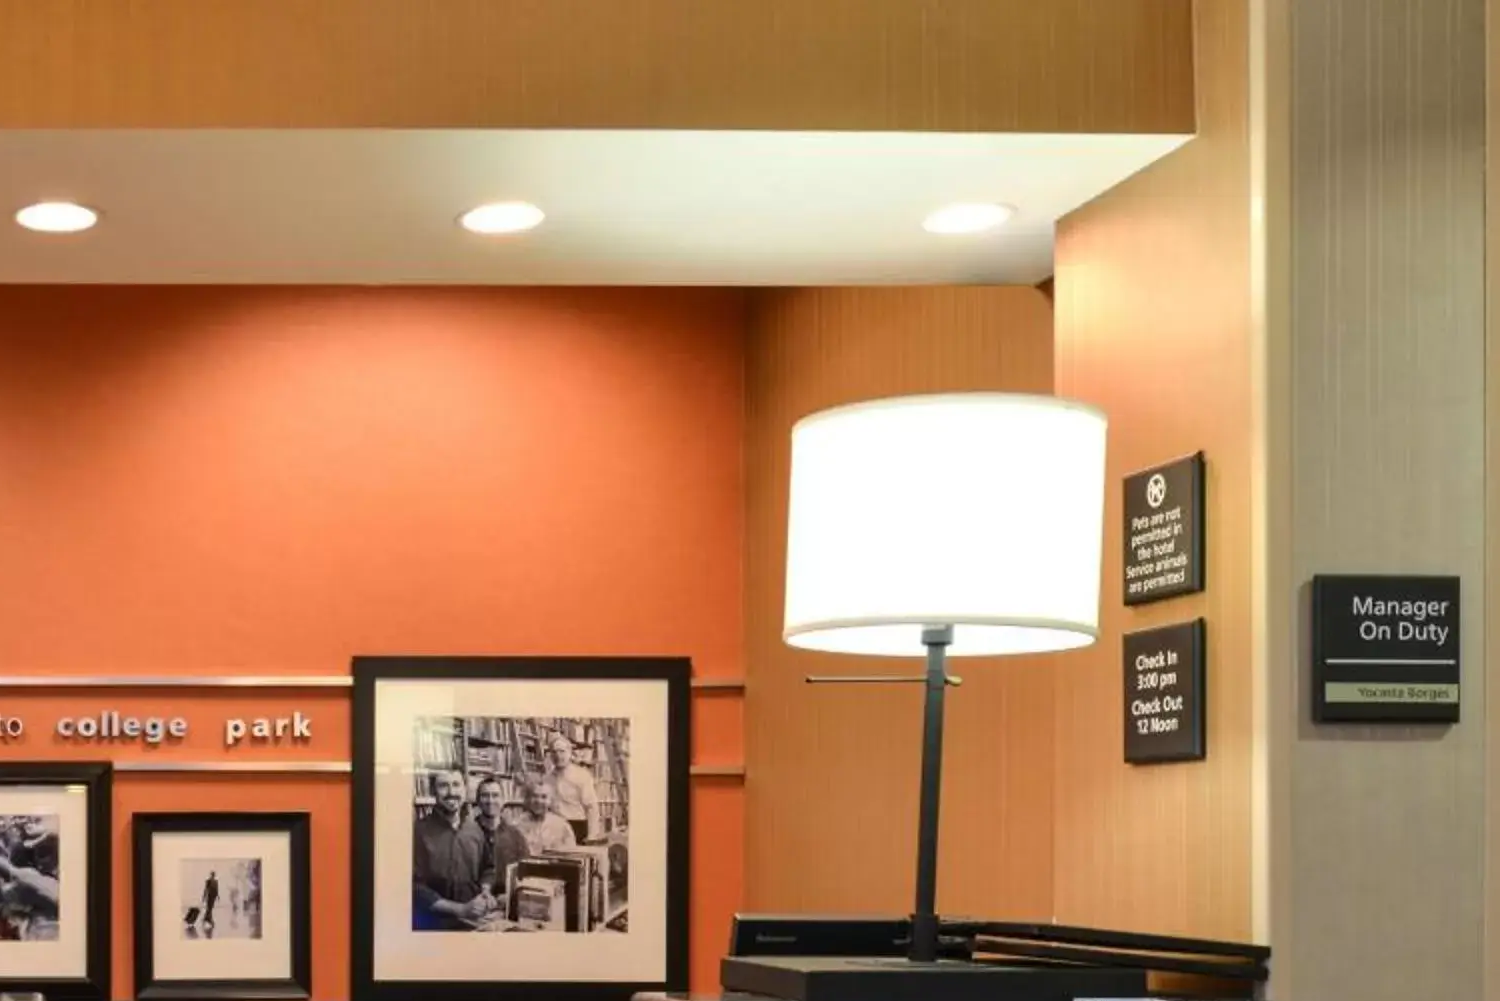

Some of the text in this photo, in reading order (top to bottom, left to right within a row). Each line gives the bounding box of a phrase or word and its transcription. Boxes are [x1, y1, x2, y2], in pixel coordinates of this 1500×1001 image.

[1126, 562, 1154, 579] Service
[1352, 596, 1449, 621] Manager
[1359, 621, 1449, 646] On Duty
[1135, 650, 1178, 671] Check In
[1137, 672, 1177, 690] 3:00 pm
[1131, 695, 1183, 716] Check Out
[56, 711, 189, 744] college
[226, 711, 312, 745] park
[1137, 717, 1178, 735] 12 Noon
